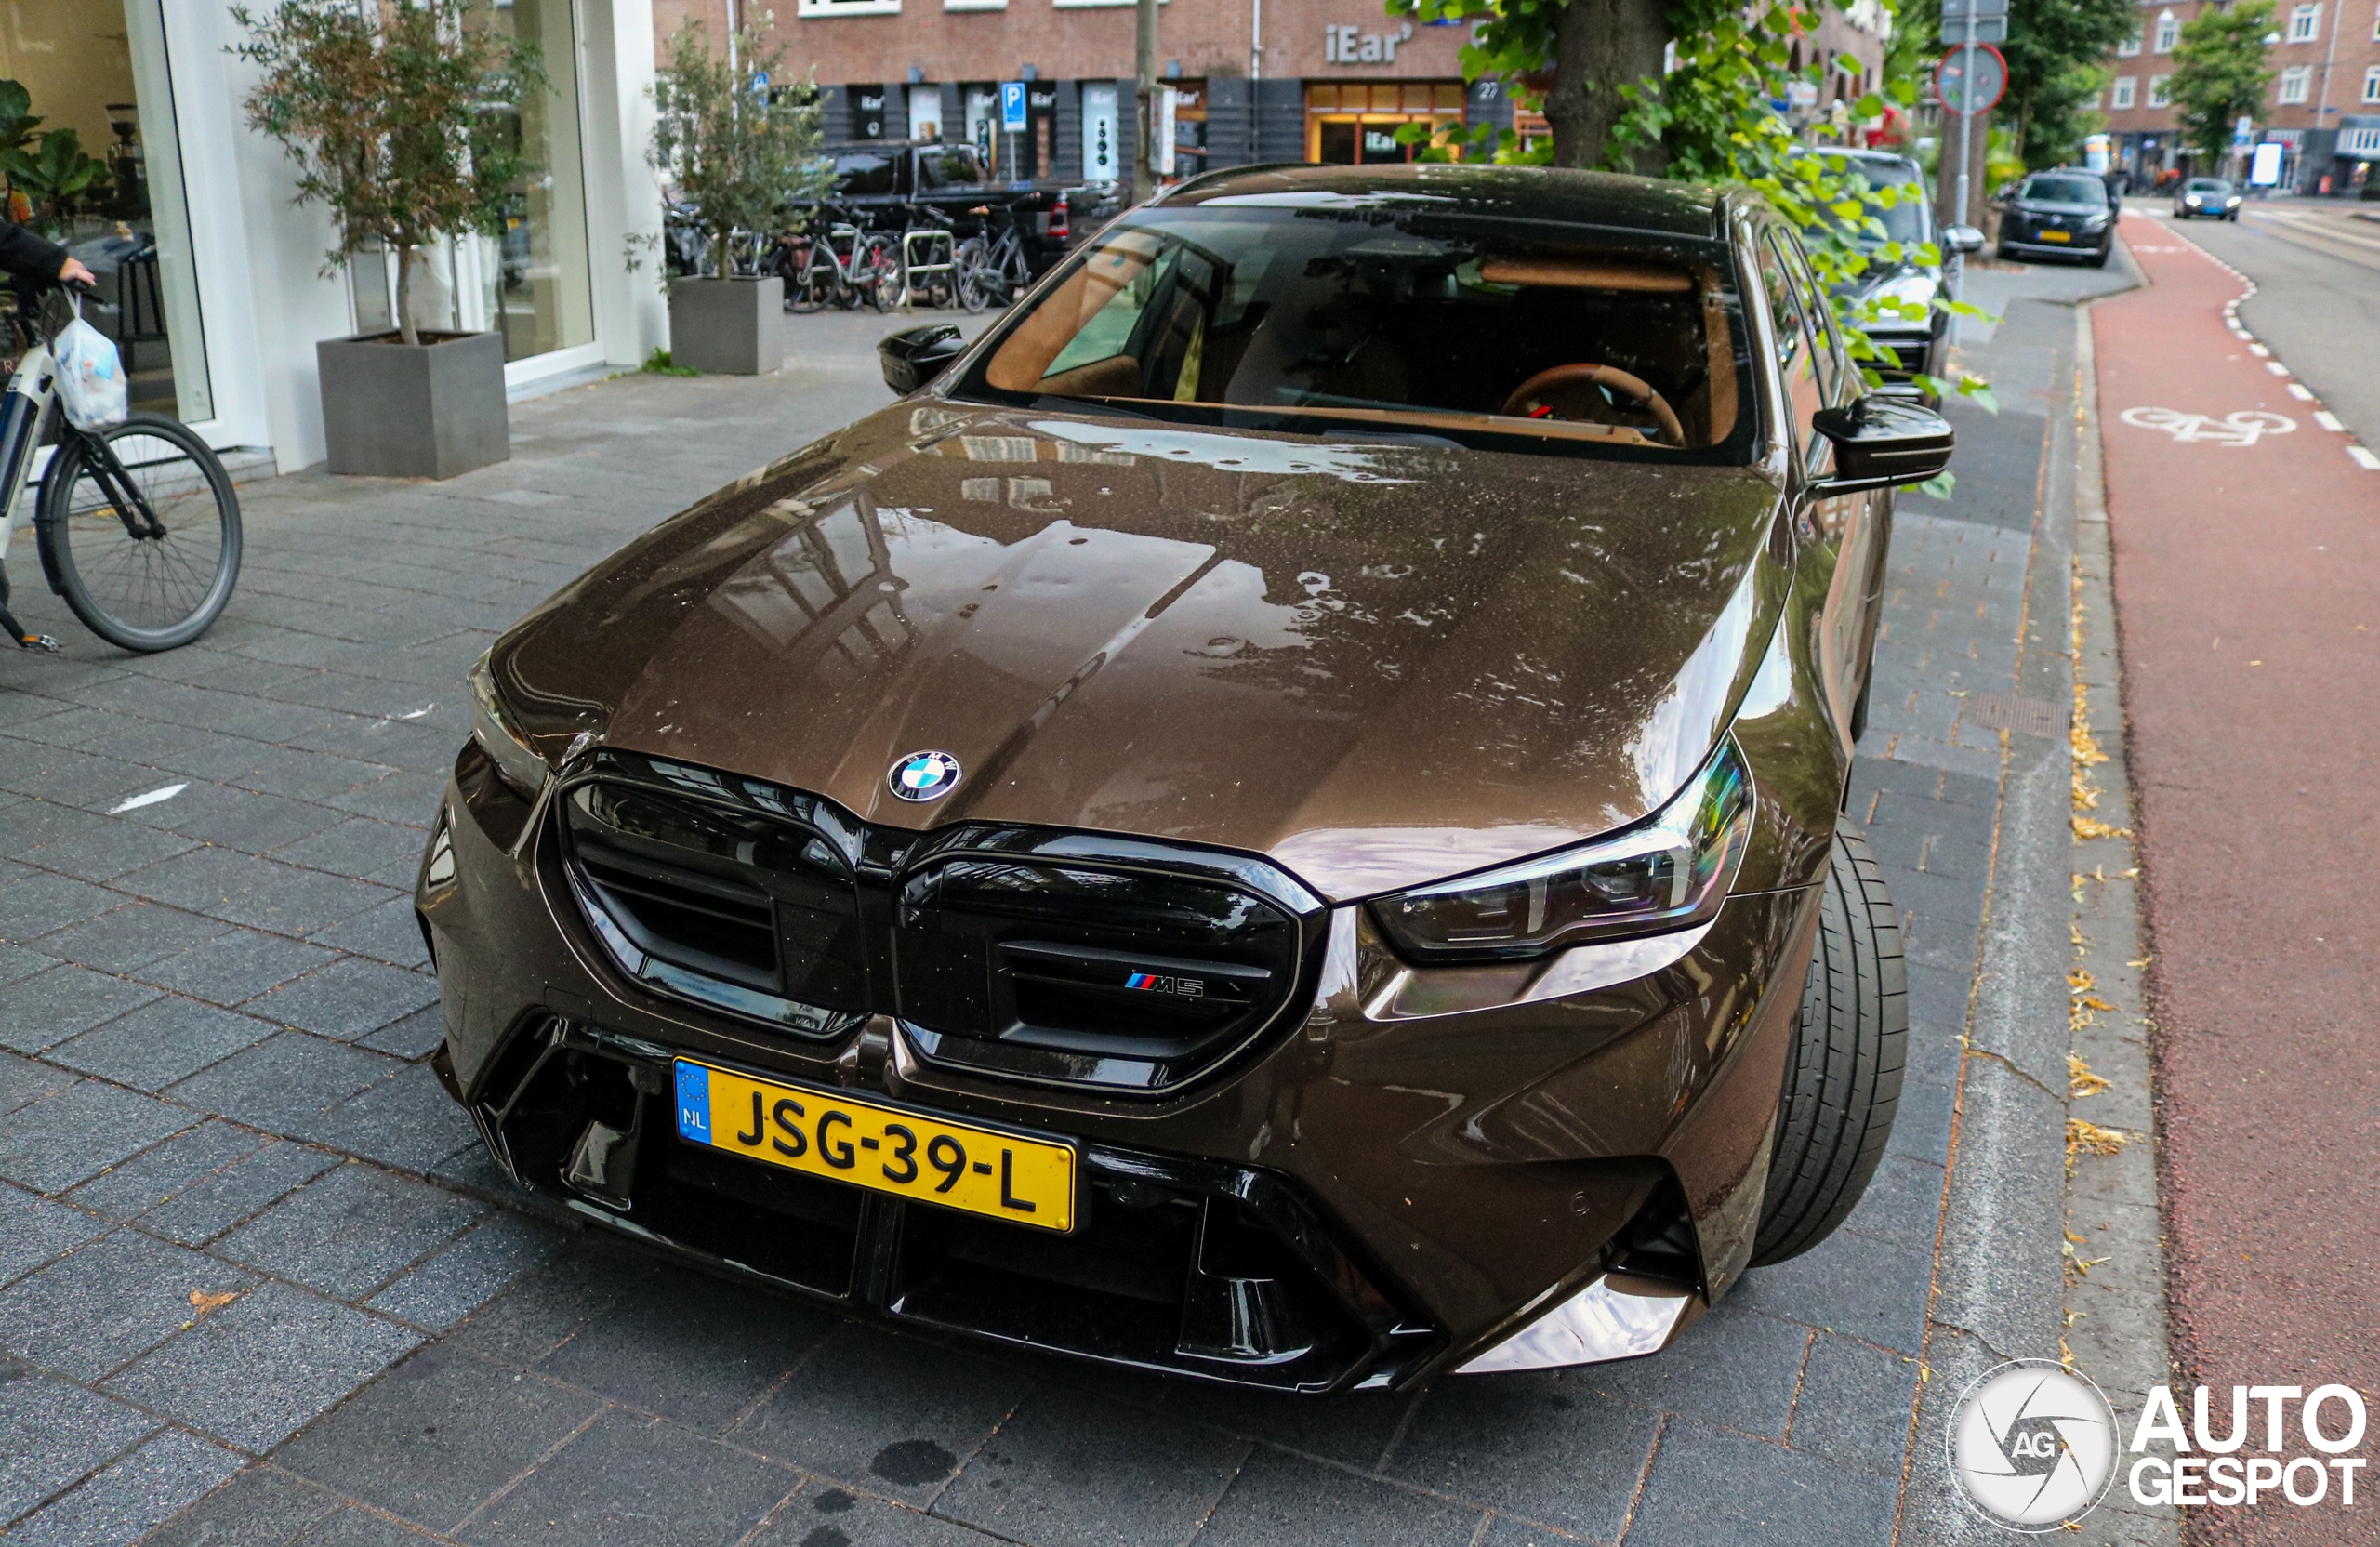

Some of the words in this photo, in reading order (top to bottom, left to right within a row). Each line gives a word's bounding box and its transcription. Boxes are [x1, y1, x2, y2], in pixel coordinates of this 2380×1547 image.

[1007, 86, 1021, 108] P
[906, 752, 957, 770] BMW
[1140, 973, 1204, 998] M5
[682, 1108, 707, 1130] NL
[737, 1091, 1037, 1212] JSG-39-L
